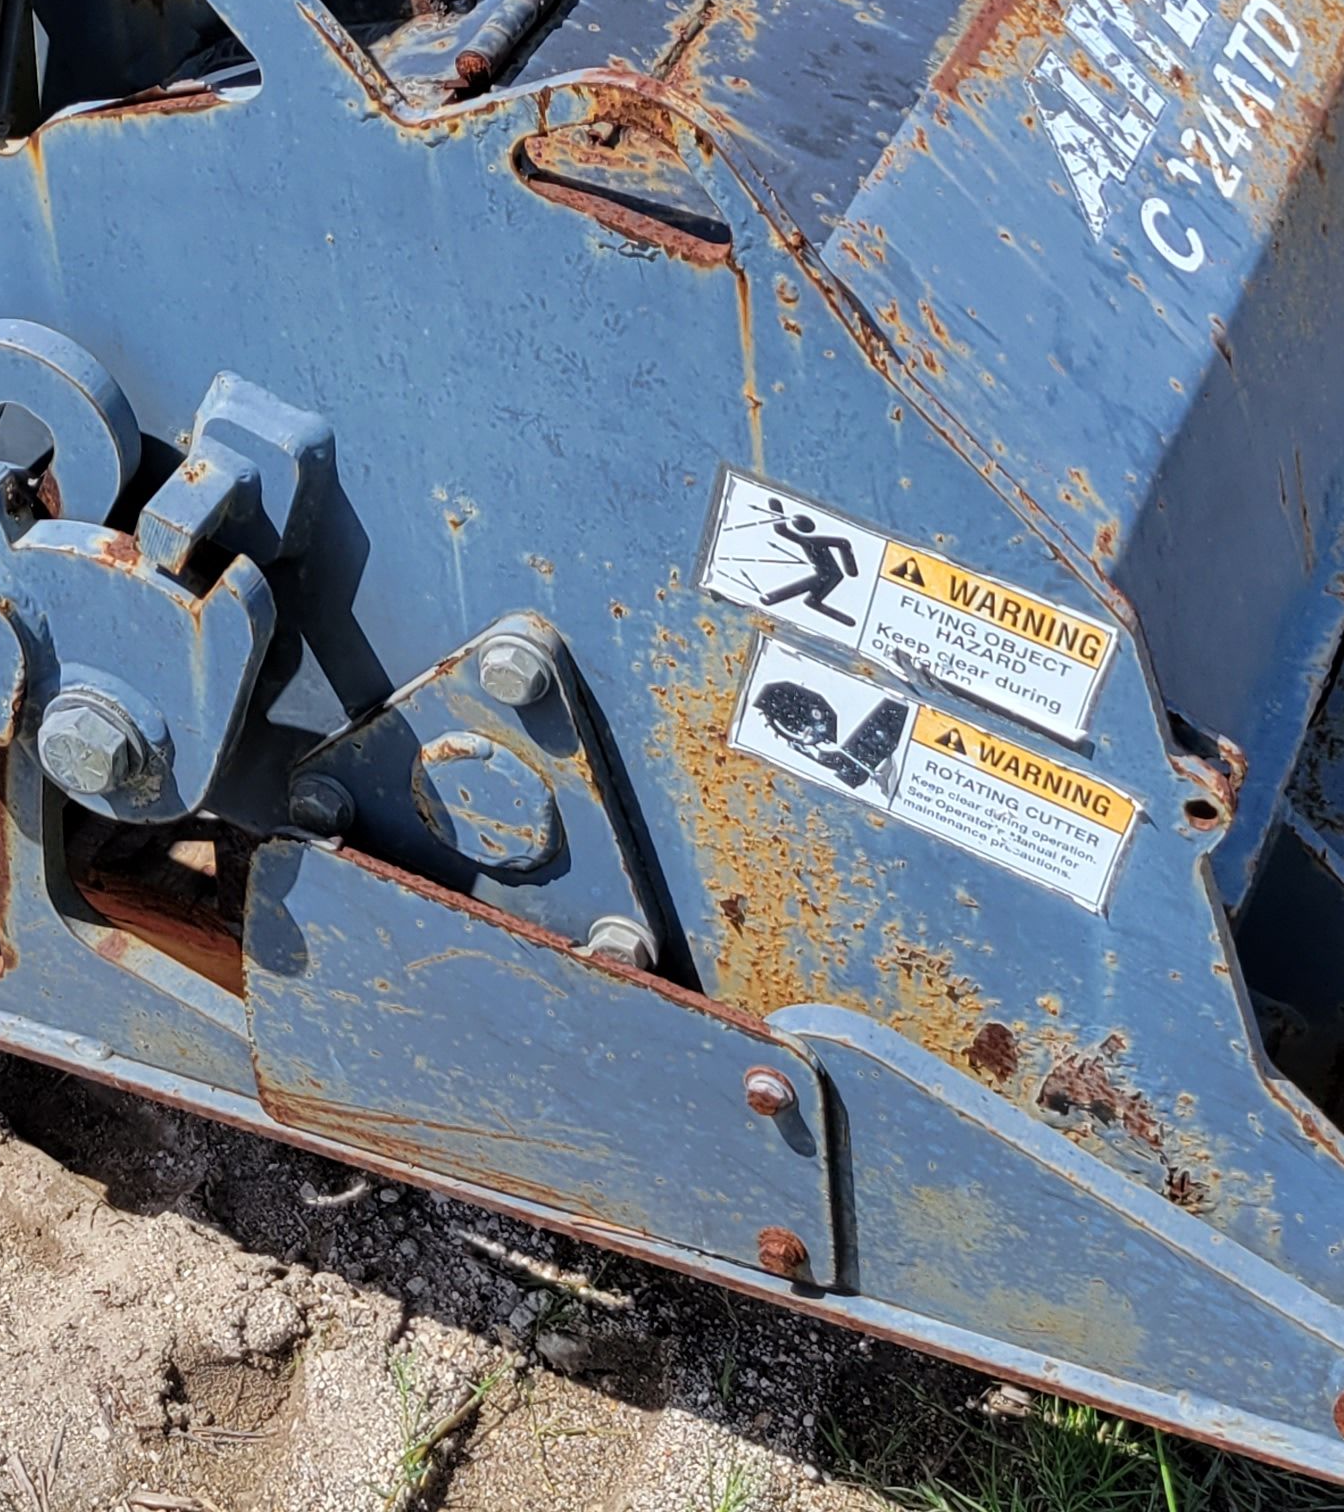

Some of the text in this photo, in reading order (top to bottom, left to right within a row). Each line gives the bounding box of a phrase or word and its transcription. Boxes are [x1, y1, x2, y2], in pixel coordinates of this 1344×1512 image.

[900, 597, 1072, 677] FLYING OBJECT
[936, 626, 1026, 675] HAZARD
[949, 575, 1101, 663] WARNING
[872, 639, 972, 686] opration
[876, 622, 1062, 715] Keep clear during
[903, 798, 988, 841] maintenance
[911, 773, 1097, 864] Keep clear during operation.
[925, 760, 1100, 847] ROTATING CUTTER
[979, 741, 1112, 818] WARNING
[907, 785, 932, 803] See
[1060, 852, 1080, 871] for
